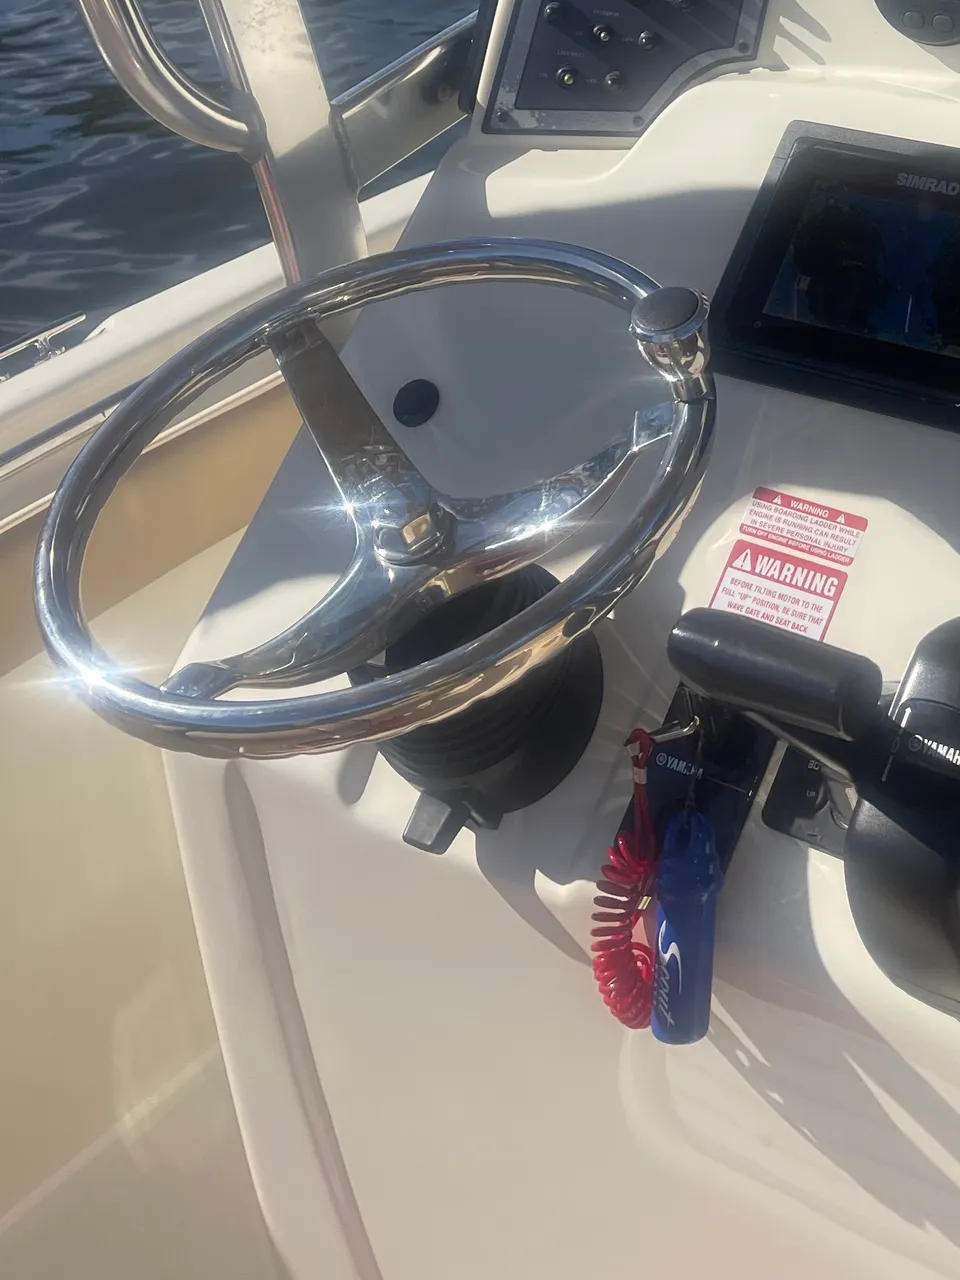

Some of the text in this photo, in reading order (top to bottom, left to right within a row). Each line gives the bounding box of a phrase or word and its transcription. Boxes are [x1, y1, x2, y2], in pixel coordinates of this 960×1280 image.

[897, 173, 960, 196] SIMRAD
[752, 501, 860, 538] USING BOARDING LADDER WHILE
[790, 500, 829, 518] WARNING
[742, 525, 756, 534] TURN
[768, 533, 788, 543] ENGINE
[788, 538, 810, 550] BEFORE
[810, 546, 826, 556] USING
[827, 551, 850, 563] LADDER
[749, 509, 774, 520] ENGINE
[783, 519, 813, 534] RUNNING
[814, 528, 829, 538] CAN
[830, 533, 857, 546] RESULT
[759, 521, 785, 534] SEVERE
[786, 529, 822, 546] PERSONAL
[823, 540, 848, 554] INJURY
[755, 554, 838, 597] WARNING
[721, 587, 735, 598] FULL
[751, 596, 783, 613] POSITION,
[782, 607, 790, 615] BE
[791, 609, 807, 620] SURE
[808, 614, 823, 626] THAT
[730, 578, 824, 613] BEFORE TILTING MOTOR TO THE
[727, 601, 808, 633] WAVE GATE AND SEAT BACK
